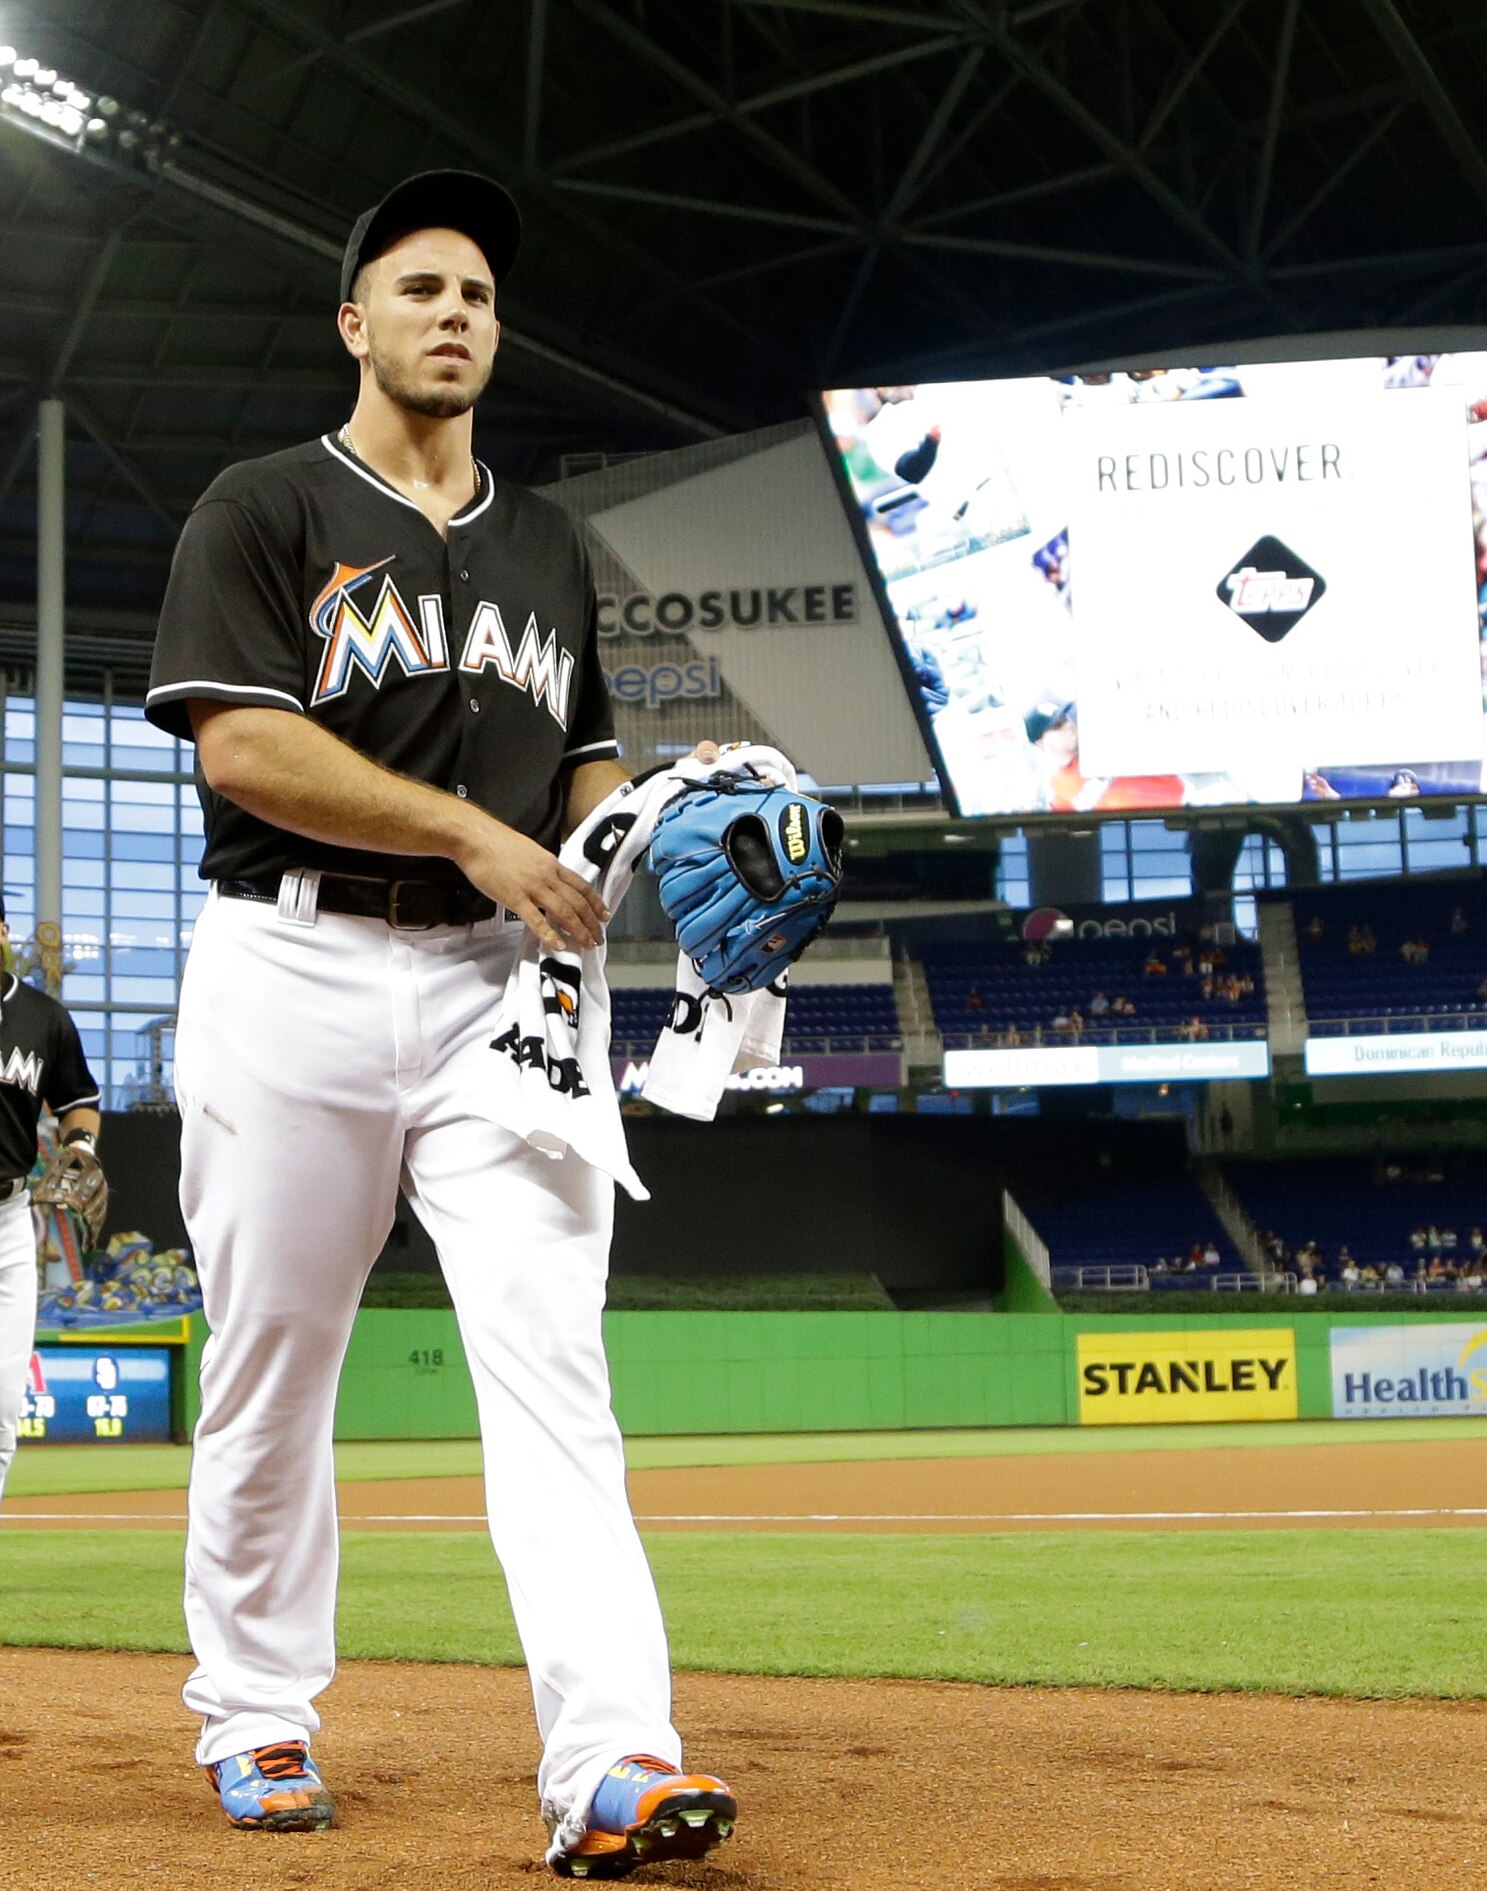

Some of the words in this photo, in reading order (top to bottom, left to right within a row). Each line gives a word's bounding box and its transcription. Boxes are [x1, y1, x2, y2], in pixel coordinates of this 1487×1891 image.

[596, 583, 856, 636] CCOSUKEE
[310, 573, 575, 733] MIAMI
[409, 1349, 443, 1365] 418
[1083, 1358, 1289, 1396] STANLEY
